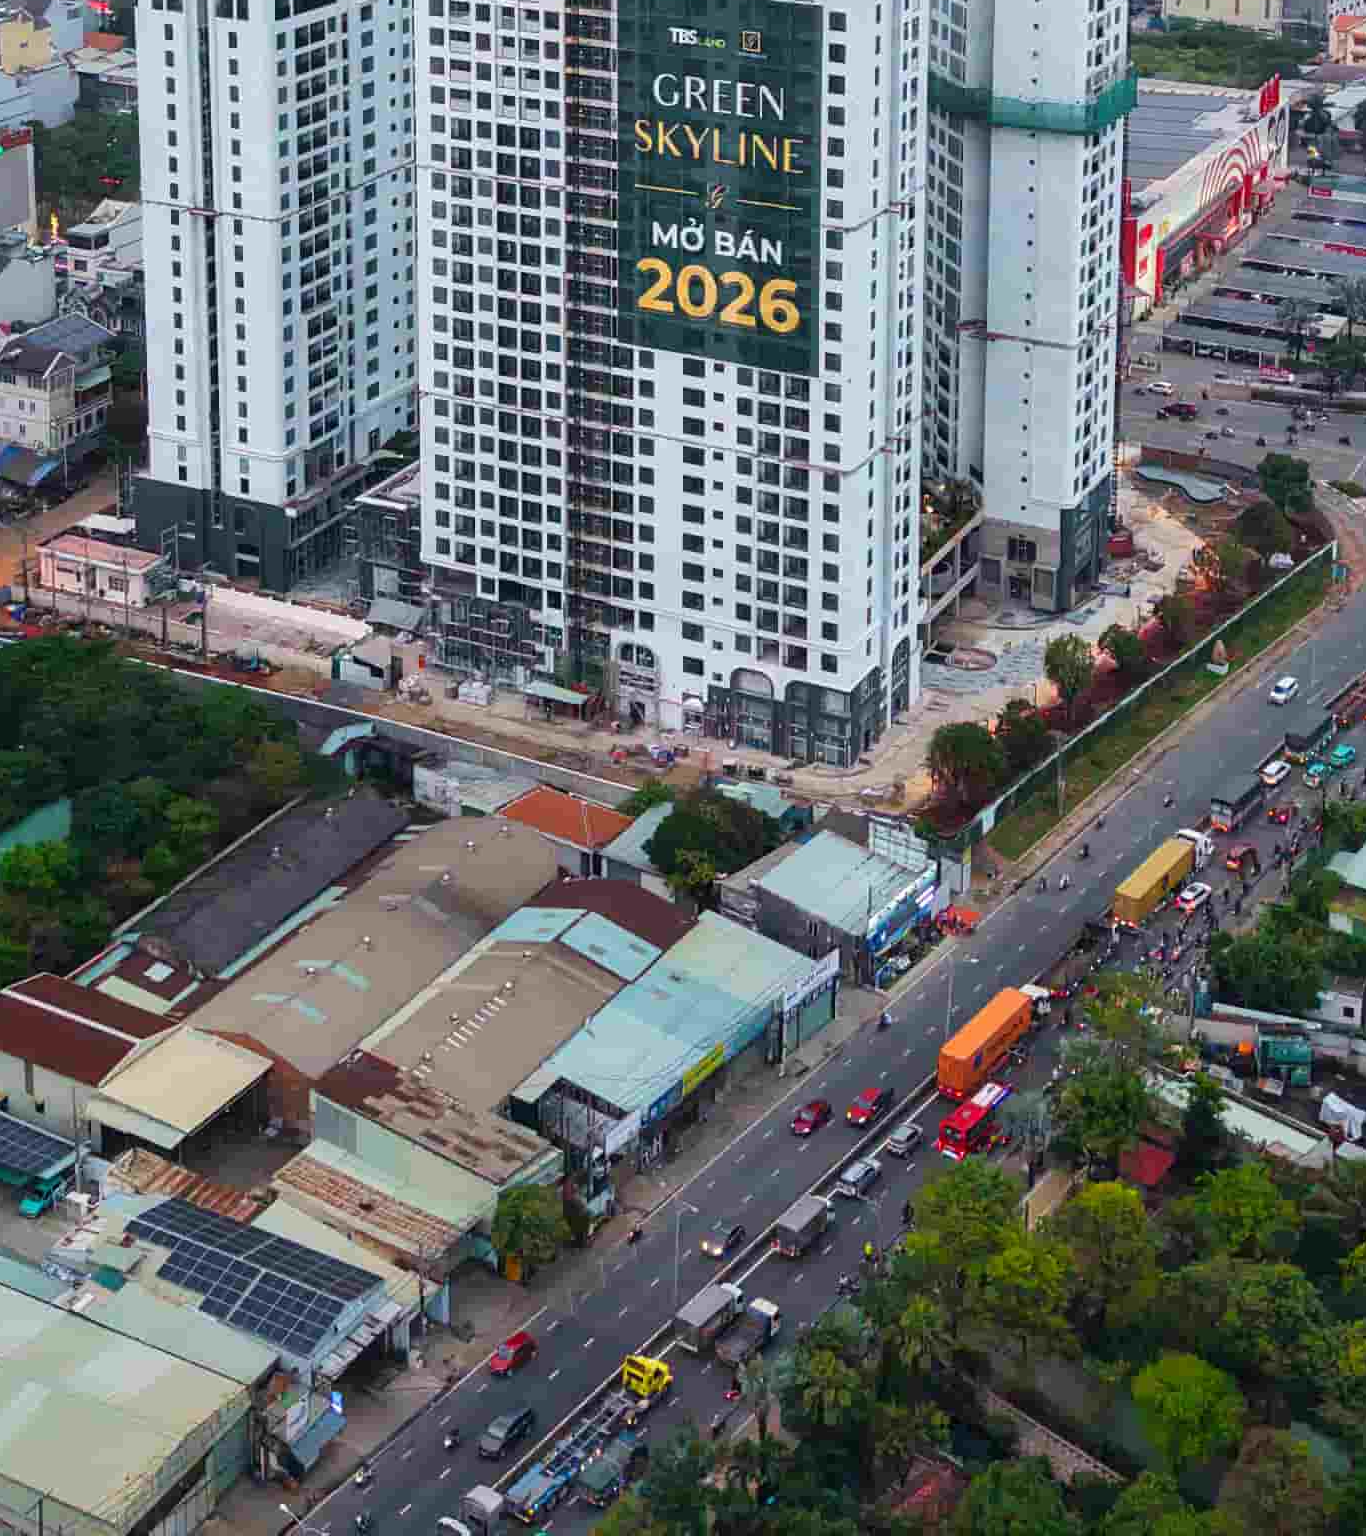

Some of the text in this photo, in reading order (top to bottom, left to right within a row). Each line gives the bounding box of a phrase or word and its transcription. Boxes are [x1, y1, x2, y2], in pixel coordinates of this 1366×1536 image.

[668, 26, 698, 45] TBS
[652, 73, 786, 120] GREEN
[634, 119, 804, 174] SKYLINE
[651, 218, 783, 265] MỞ BÁN
[636, 257, 801, 334] 2026
